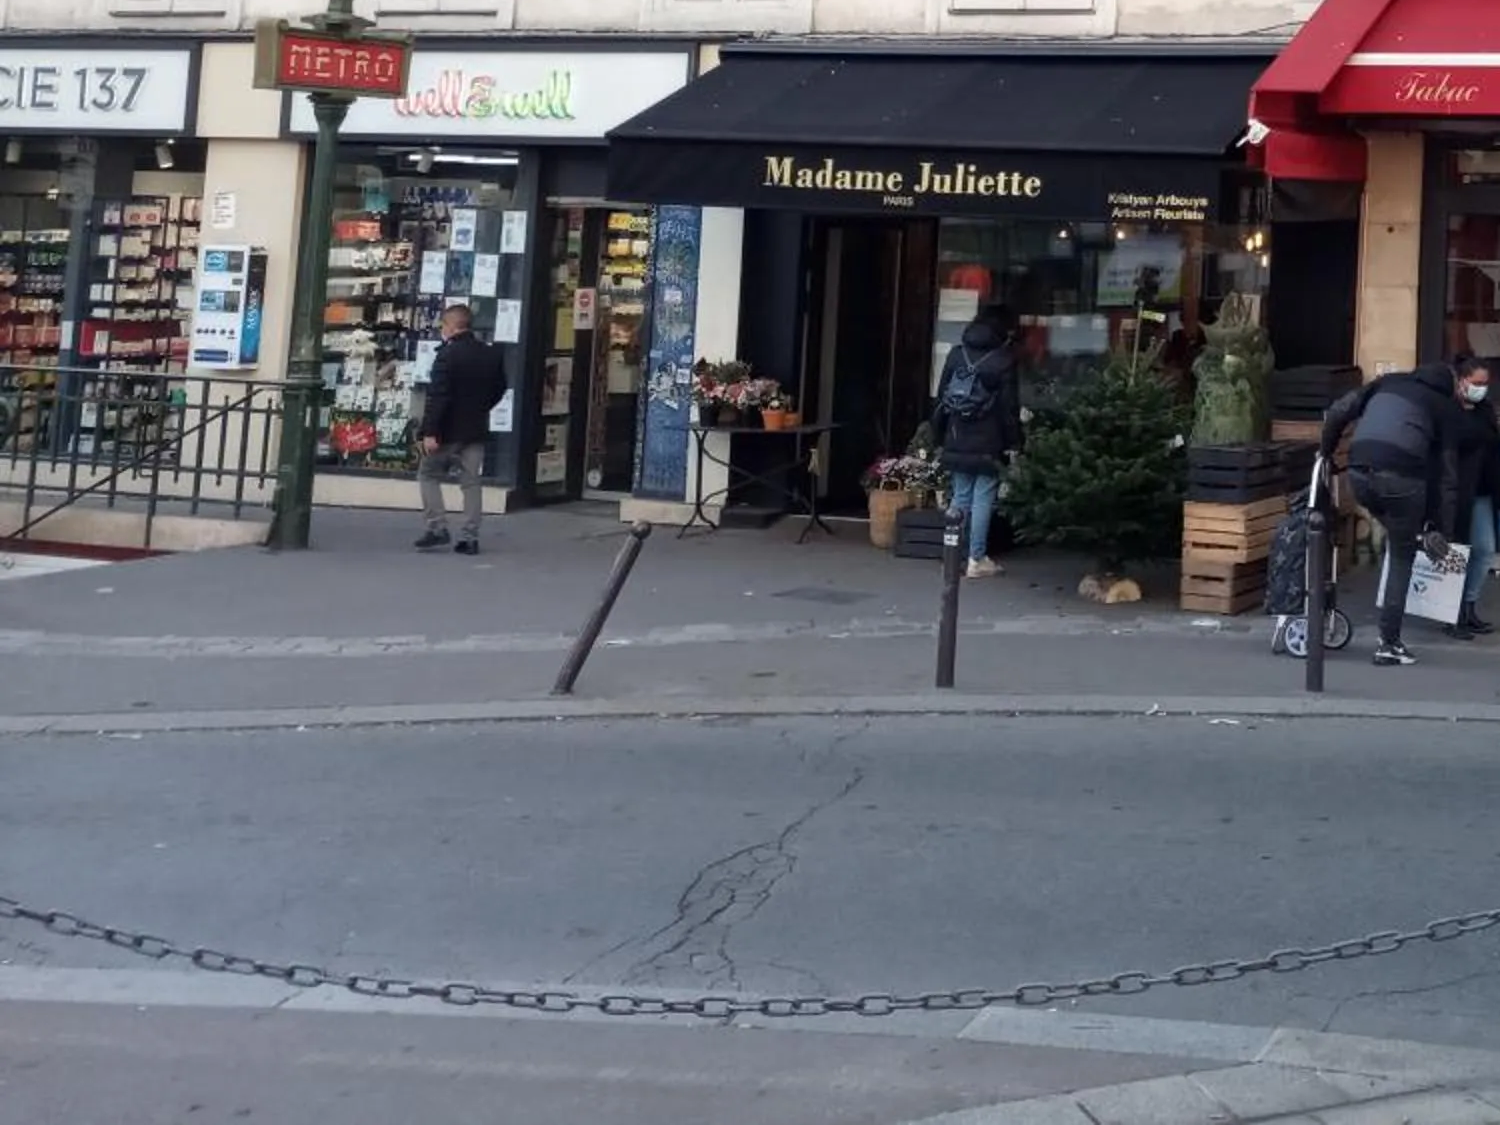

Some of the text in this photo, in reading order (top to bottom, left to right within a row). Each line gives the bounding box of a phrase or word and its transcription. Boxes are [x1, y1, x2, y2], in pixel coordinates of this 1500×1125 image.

[289, 43, 394, 83] METRO
[74, 66, 148, 112] 137
[501, 70, 576, 120] well
[1395, 71, 1480, 103] Tabac
[762, 156, 1042, 198] Madame Juliette
